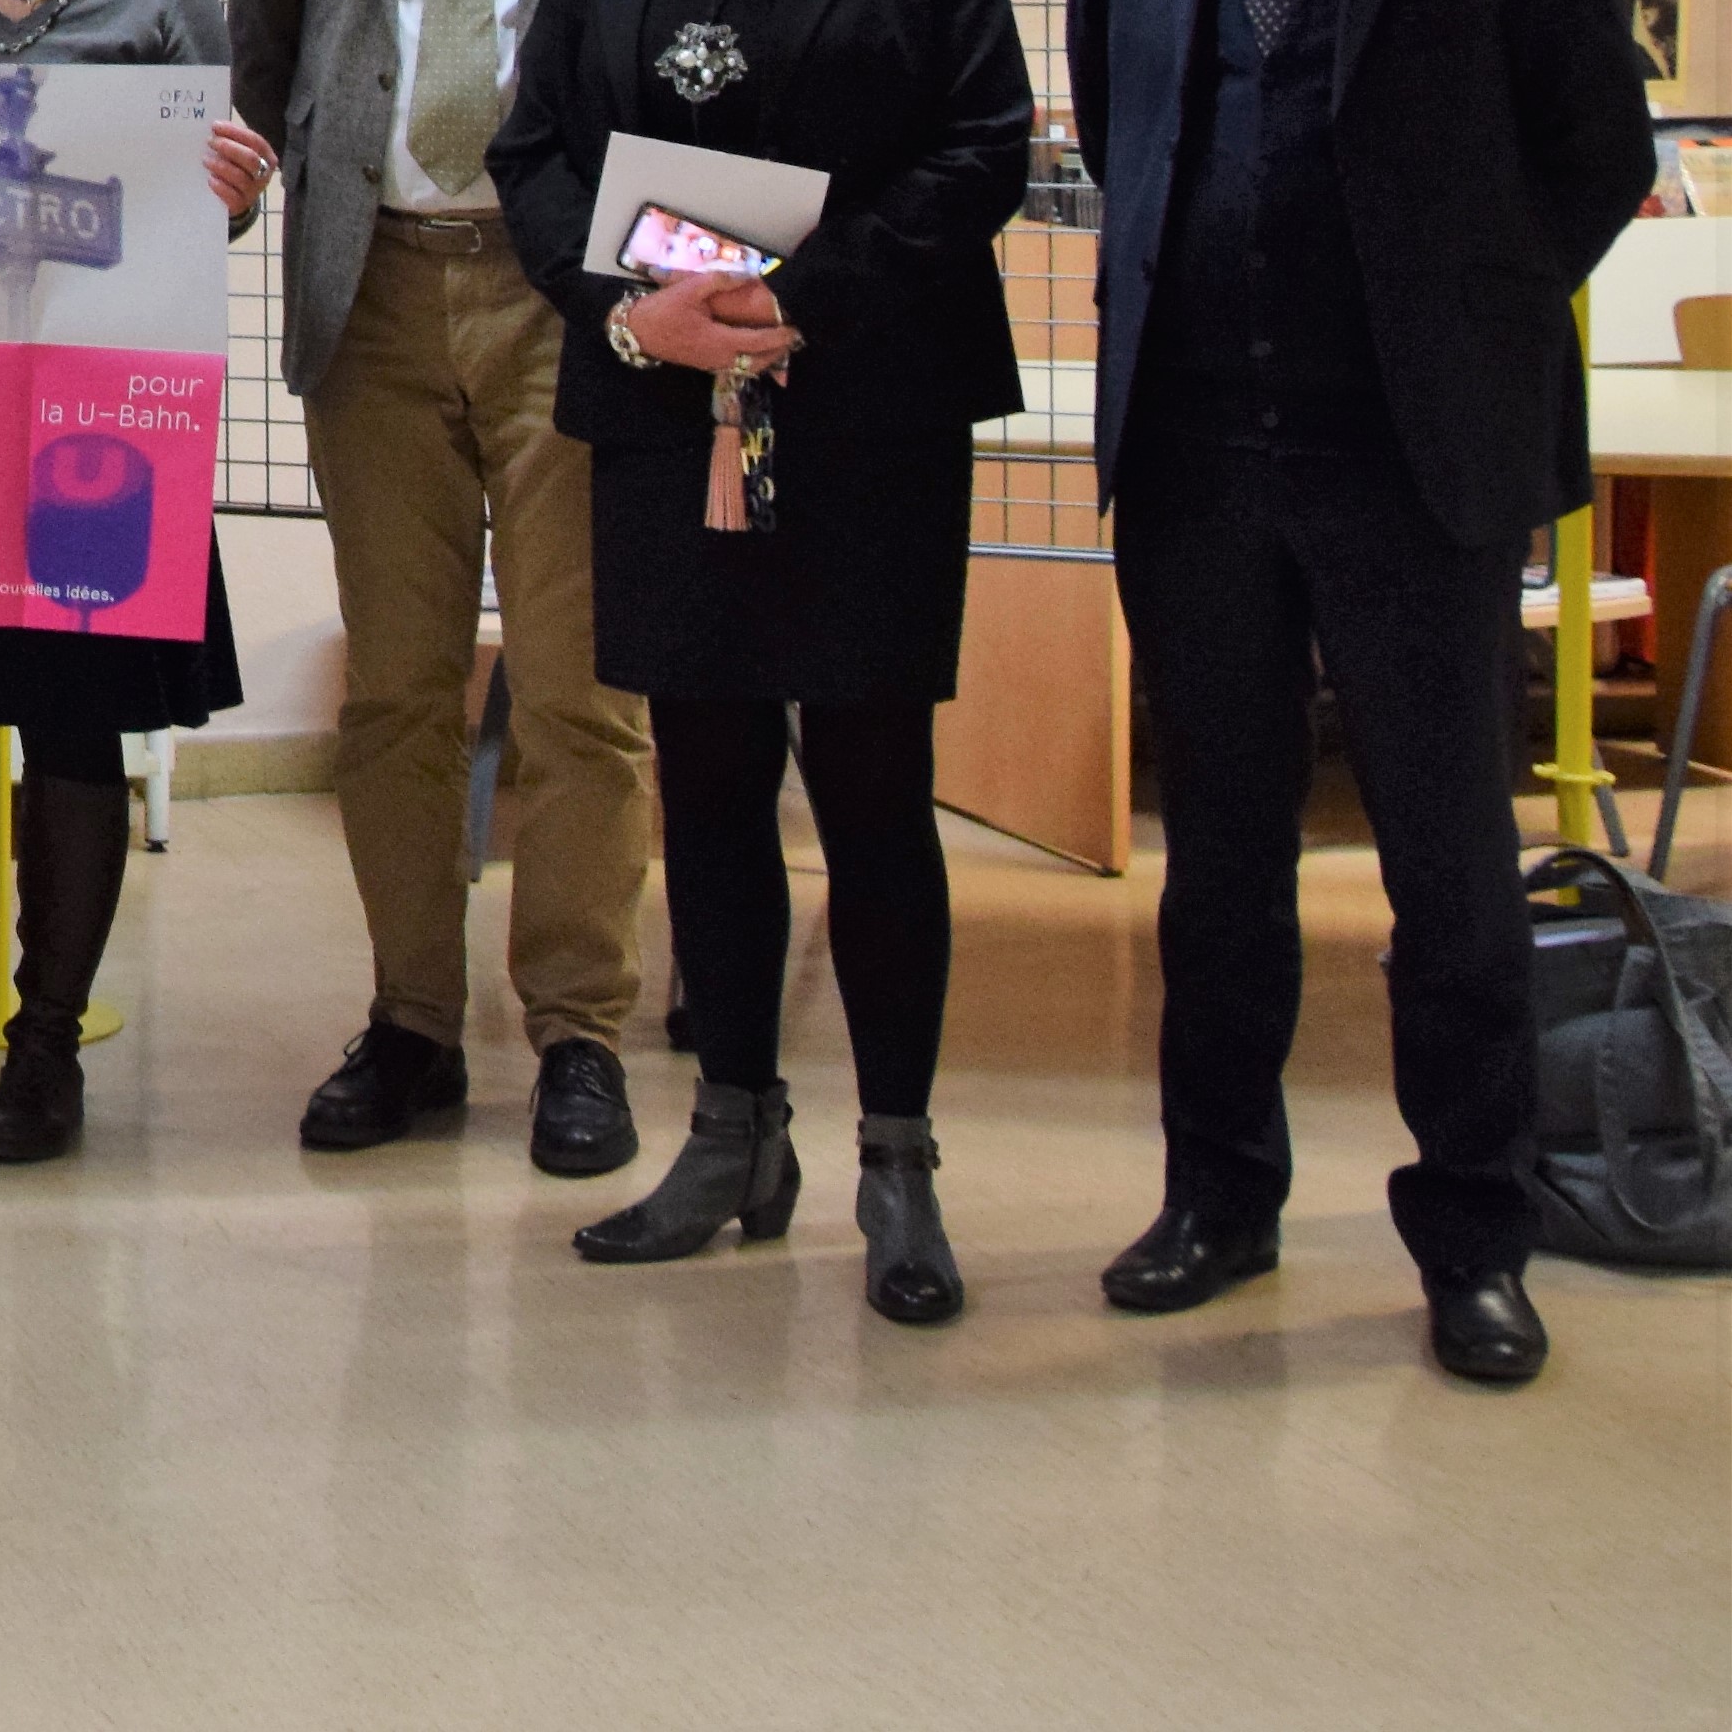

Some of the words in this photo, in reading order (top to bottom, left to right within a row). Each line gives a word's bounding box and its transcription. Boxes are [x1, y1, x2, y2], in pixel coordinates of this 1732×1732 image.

[159, 90, 205, 102] OFAJ
[160, 106, 206, 119] DFJW
[128, 375, 204, 400] pour
[41, 398, 63, 424] la
[78, 402, 200, 432] U-Bahn.
[66, 584, 115, 602] idées.
